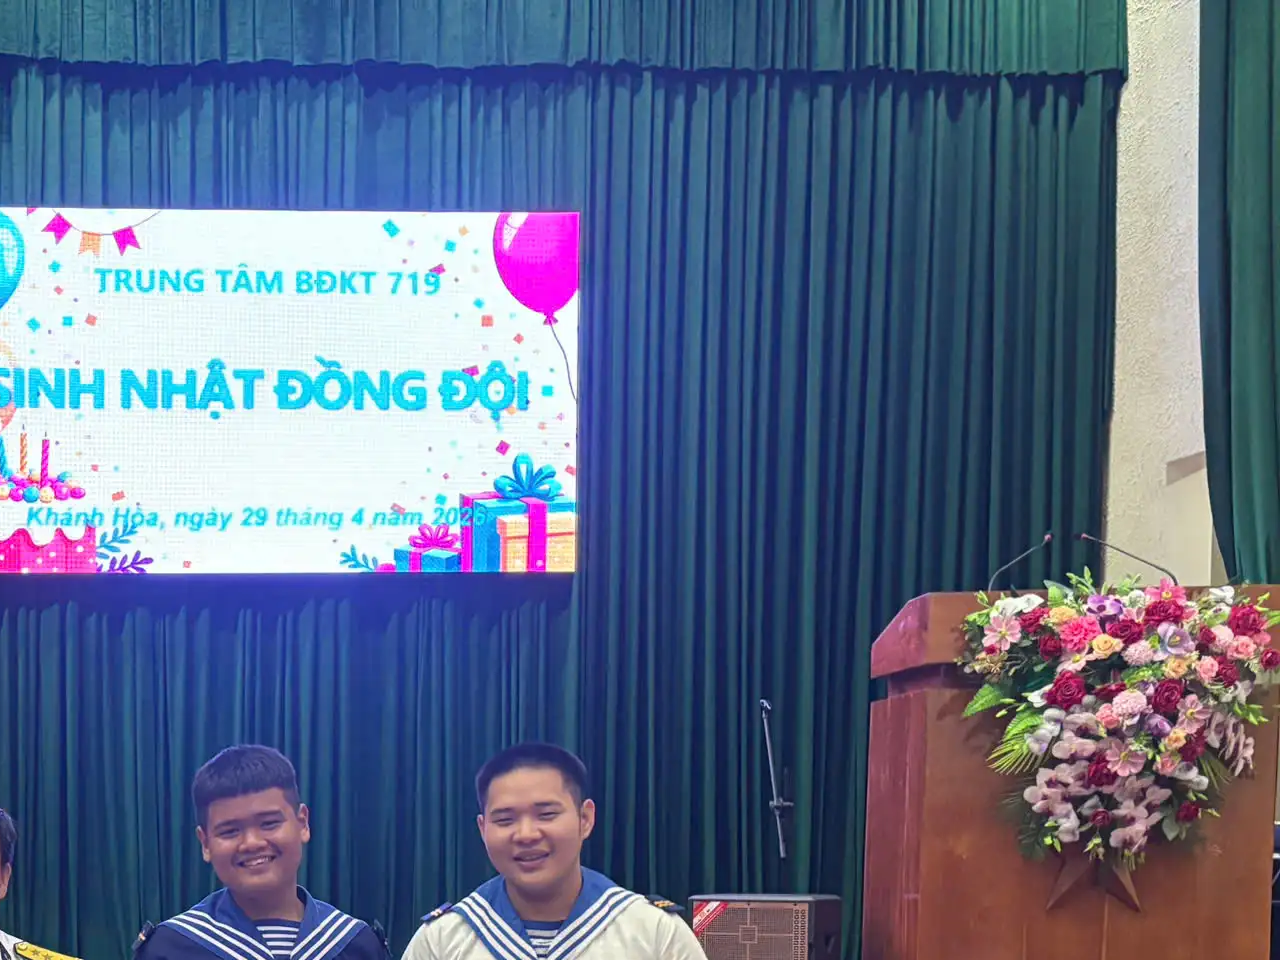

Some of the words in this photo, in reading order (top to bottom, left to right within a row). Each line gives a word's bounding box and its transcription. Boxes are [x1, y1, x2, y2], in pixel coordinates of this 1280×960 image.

[95, 268, 204, 293] TRUNG
[216, 263, 283, 293] TÂM
[296, 271, 377, 294] BĐKT
[387, 271, 441, 296] 719
[121, 358, 265, 420] NHẬT
[273, 355, 428, 411] ĐỒNG
[438, 360, 529, 422] ĐỘI
[26, 506, 105, 527] Khánh
[112, 504, 166, 530] Hòa,
[174, 506, 233, 531] ngày
[240, 506, 268, 527] 29
[276, 506, 344, 530] tháng
[351, 507, 365, 526] 4
